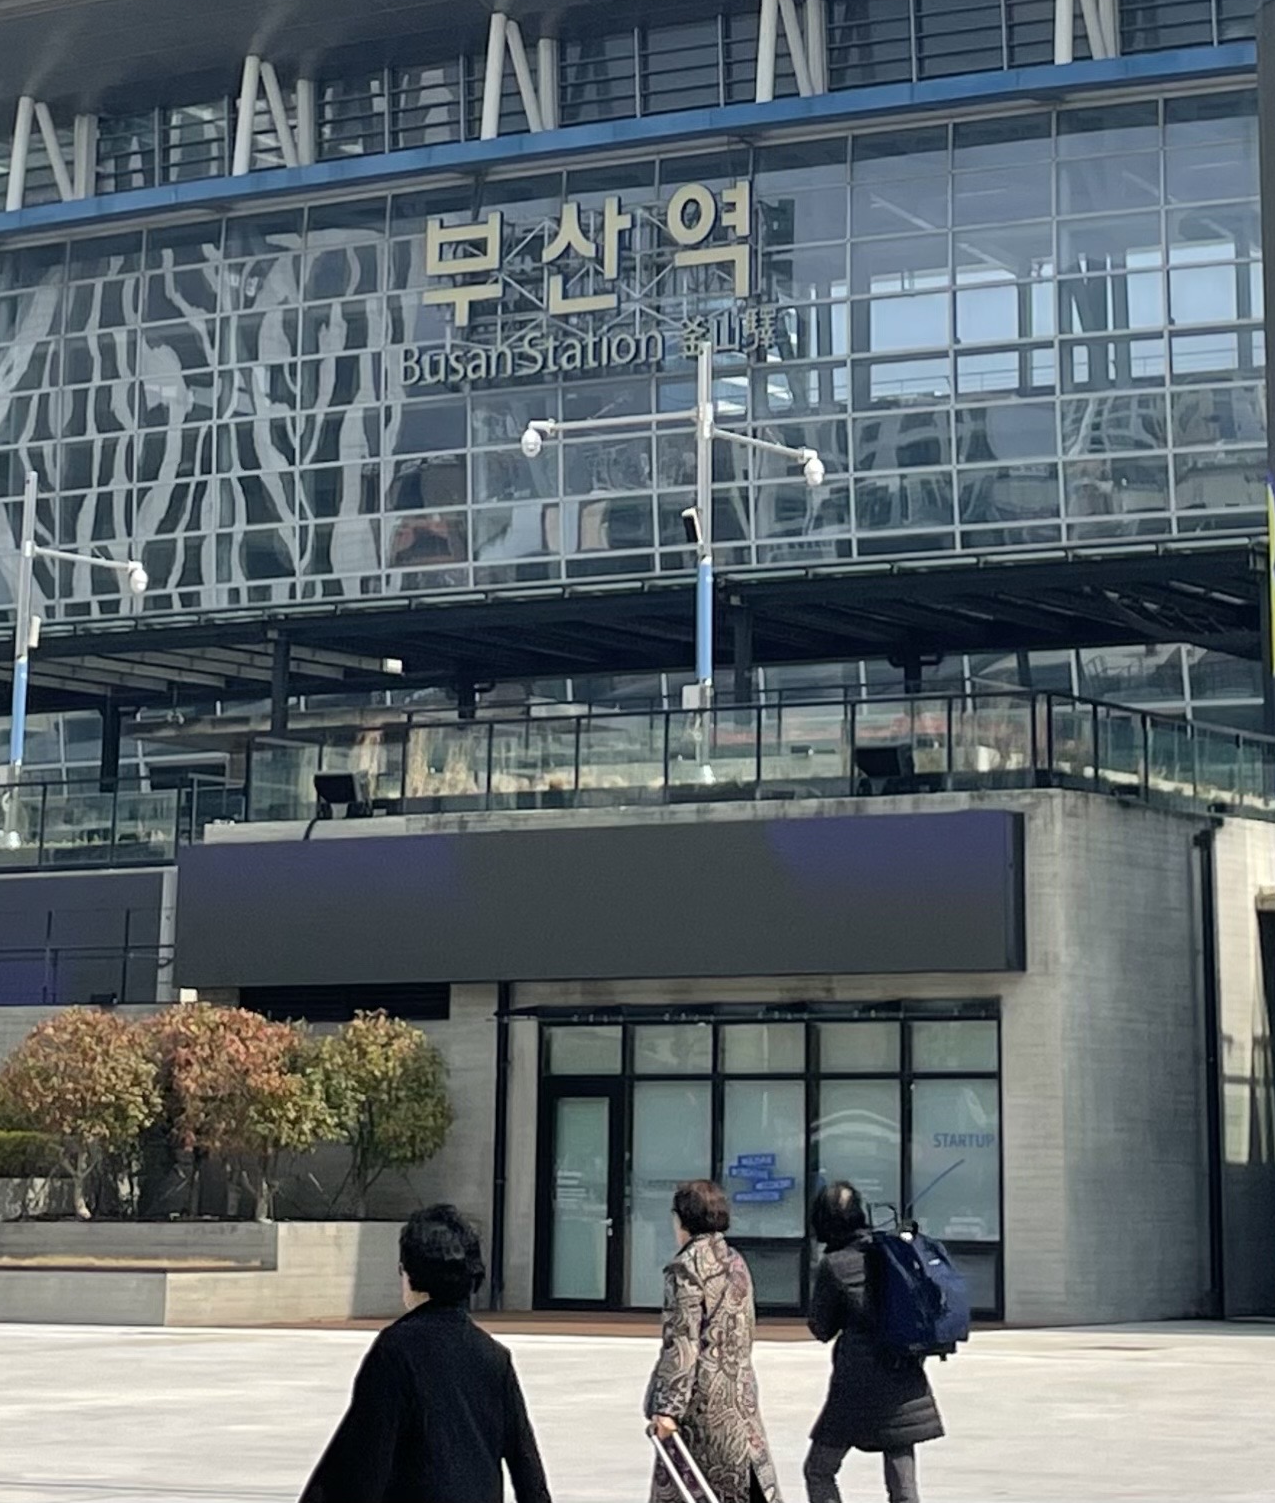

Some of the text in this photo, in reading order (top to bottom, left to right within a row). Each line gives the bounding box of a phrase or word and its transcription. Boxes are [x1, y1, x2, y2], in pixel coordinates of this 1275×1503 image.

[422, 180, 752, 327] 부산역
[400, 328, 664, 386] Busan Station
[933, 1132, 996, 1149] STARTUP
